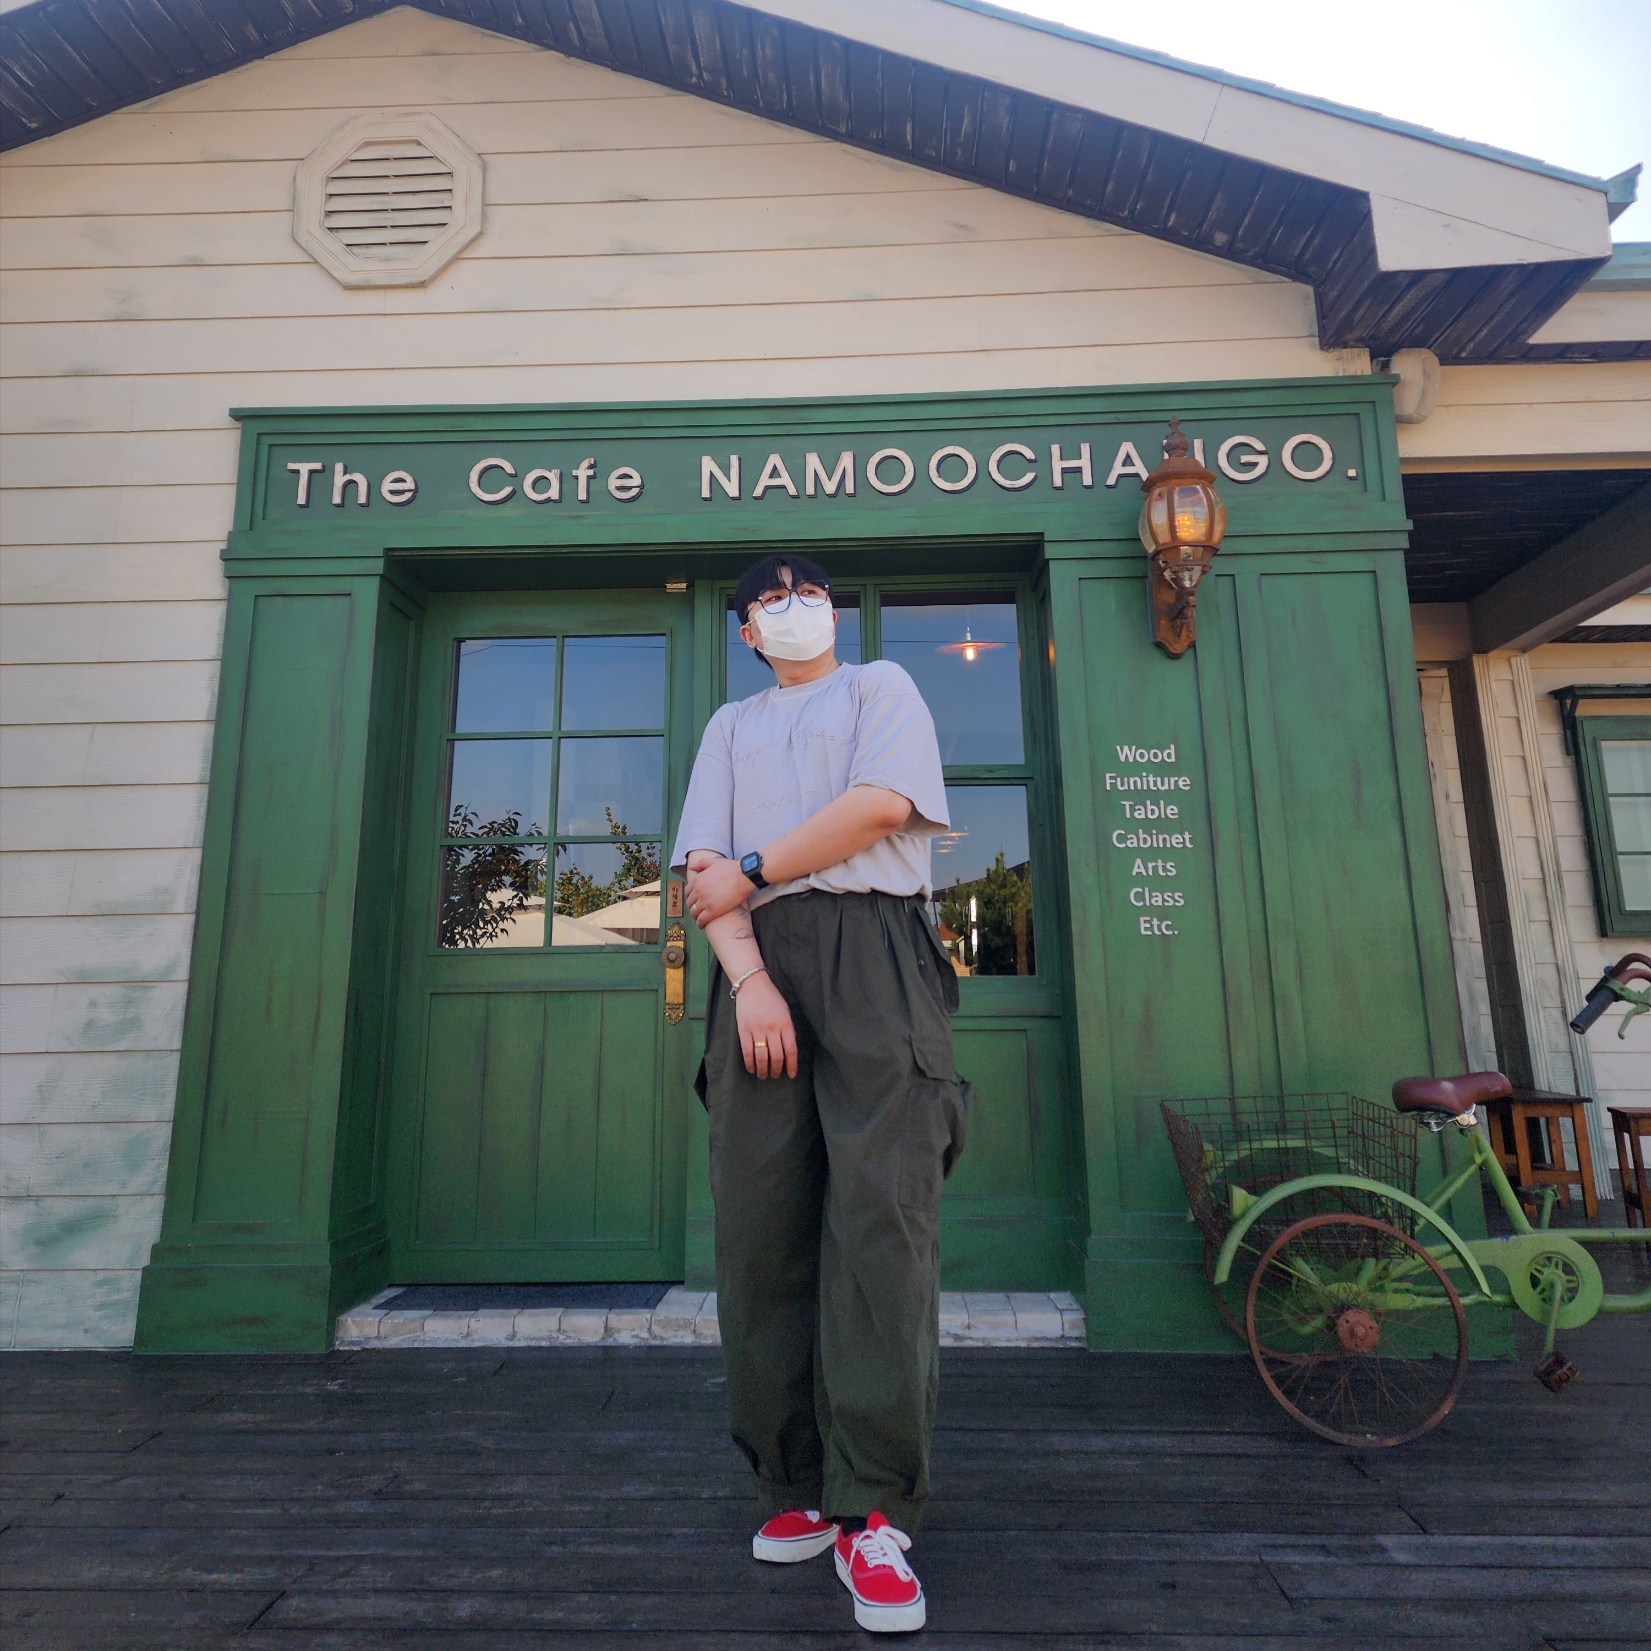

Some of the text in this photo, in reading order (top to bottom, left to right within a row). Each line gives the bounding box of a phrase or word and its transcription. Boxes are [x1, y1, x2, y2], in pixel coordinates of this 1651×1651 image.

[286, 461, 418, 507] The
[468, 457, 644, 504] Cafe
[1116, 744, 1176, 763] Wood
[1105, 772, 1191, 791] Funiture
[1120, 800, 1179, 819] Table
[1112, 829, 1193, 848] Cabinet
[1132, 858, 1177, 876] Arts
[1129, 887, 1185, 906] Class
[1139, 916, 1179, 935] Etc.
